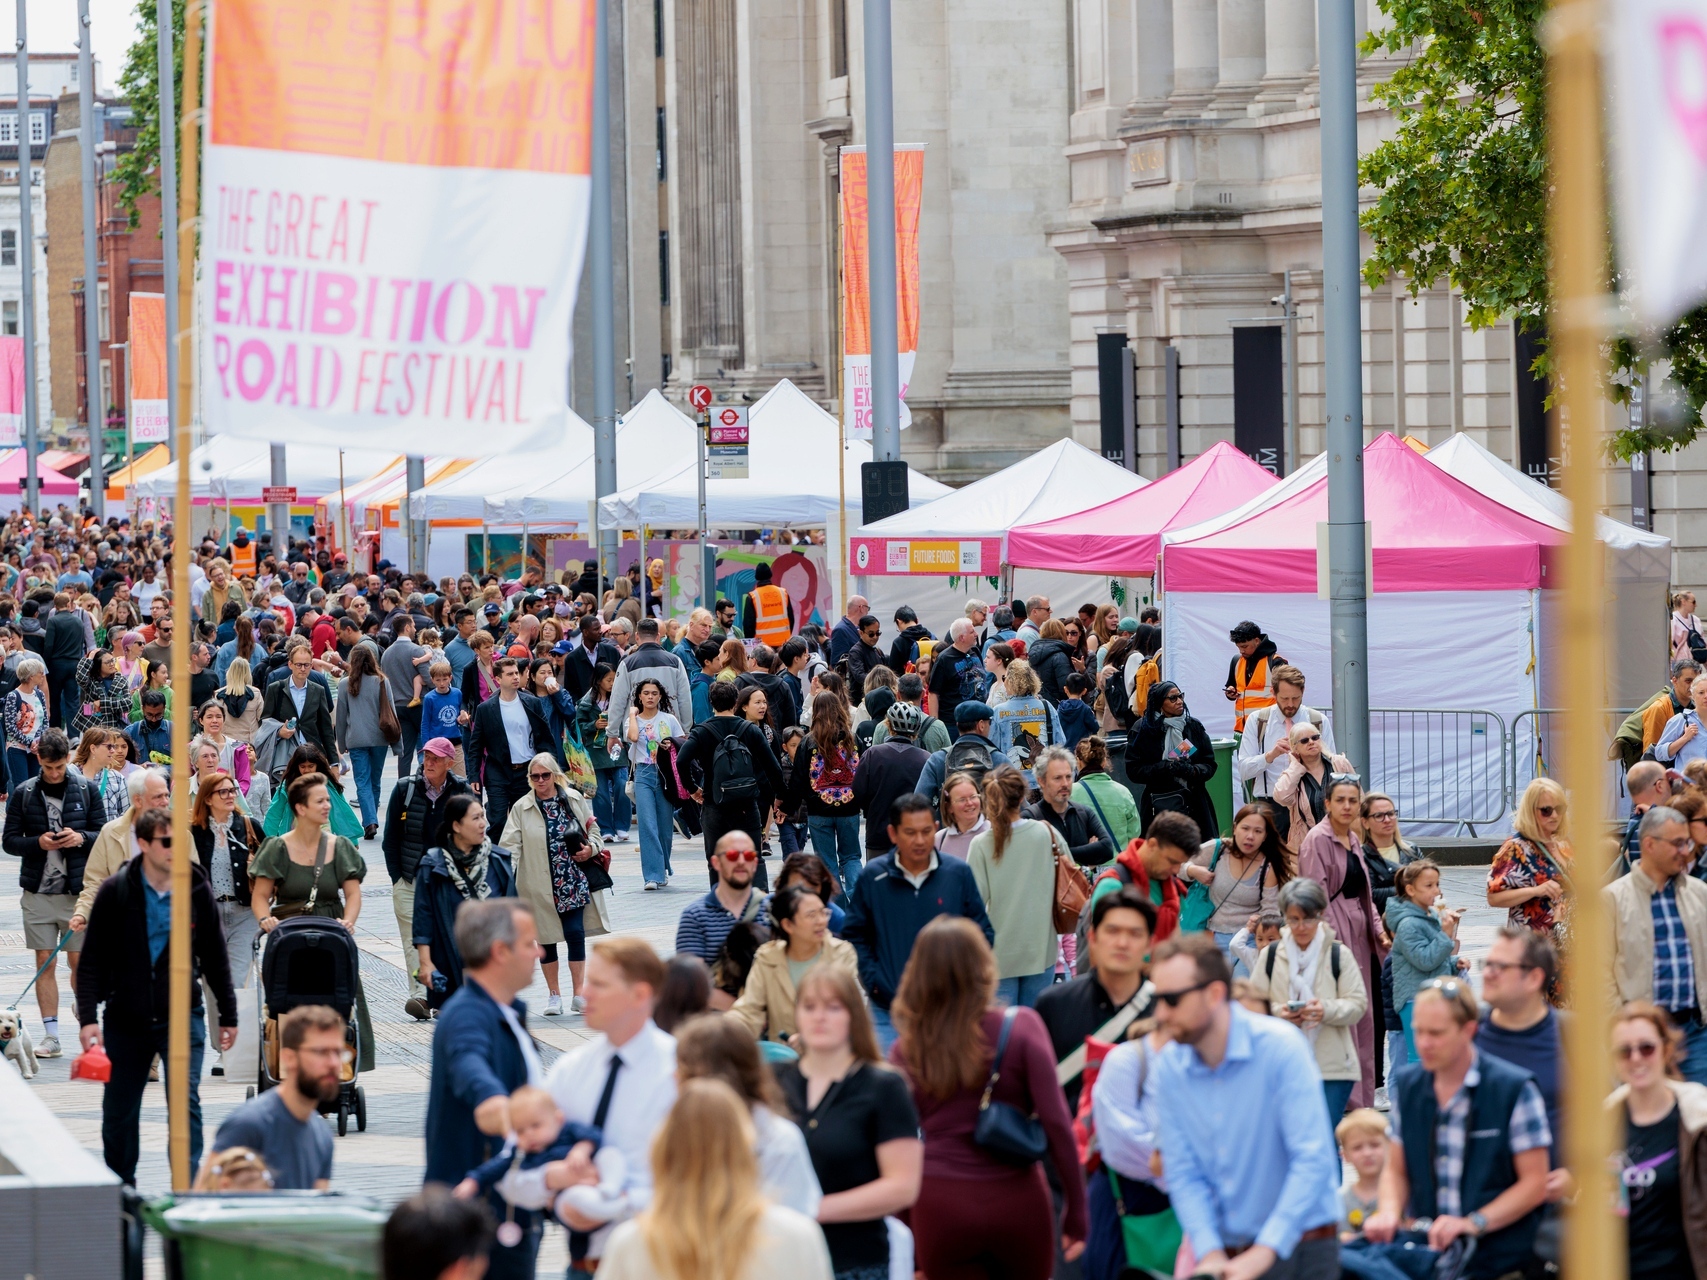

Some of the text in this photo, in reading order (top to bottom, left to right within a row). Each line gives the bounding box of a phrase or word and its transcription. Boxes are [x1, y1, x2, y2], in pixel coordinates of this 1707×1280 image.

[851, 166, 868, 221] PLAY
[217, 185, 380, 264] THE GREAT
[214, 260, 548, 350] EXHIBITION
[214, 334, 531, 424] ROAD FESTIVAL
[852, 366, 869, 386] THE
[693, 388, 707, 406] K
[860, 551, 865, 562] 8
[913, 550, 935, 563] FUTURE
[936, 550, 955, 564] FOODS
[763, 601, 782, 609] Steward
